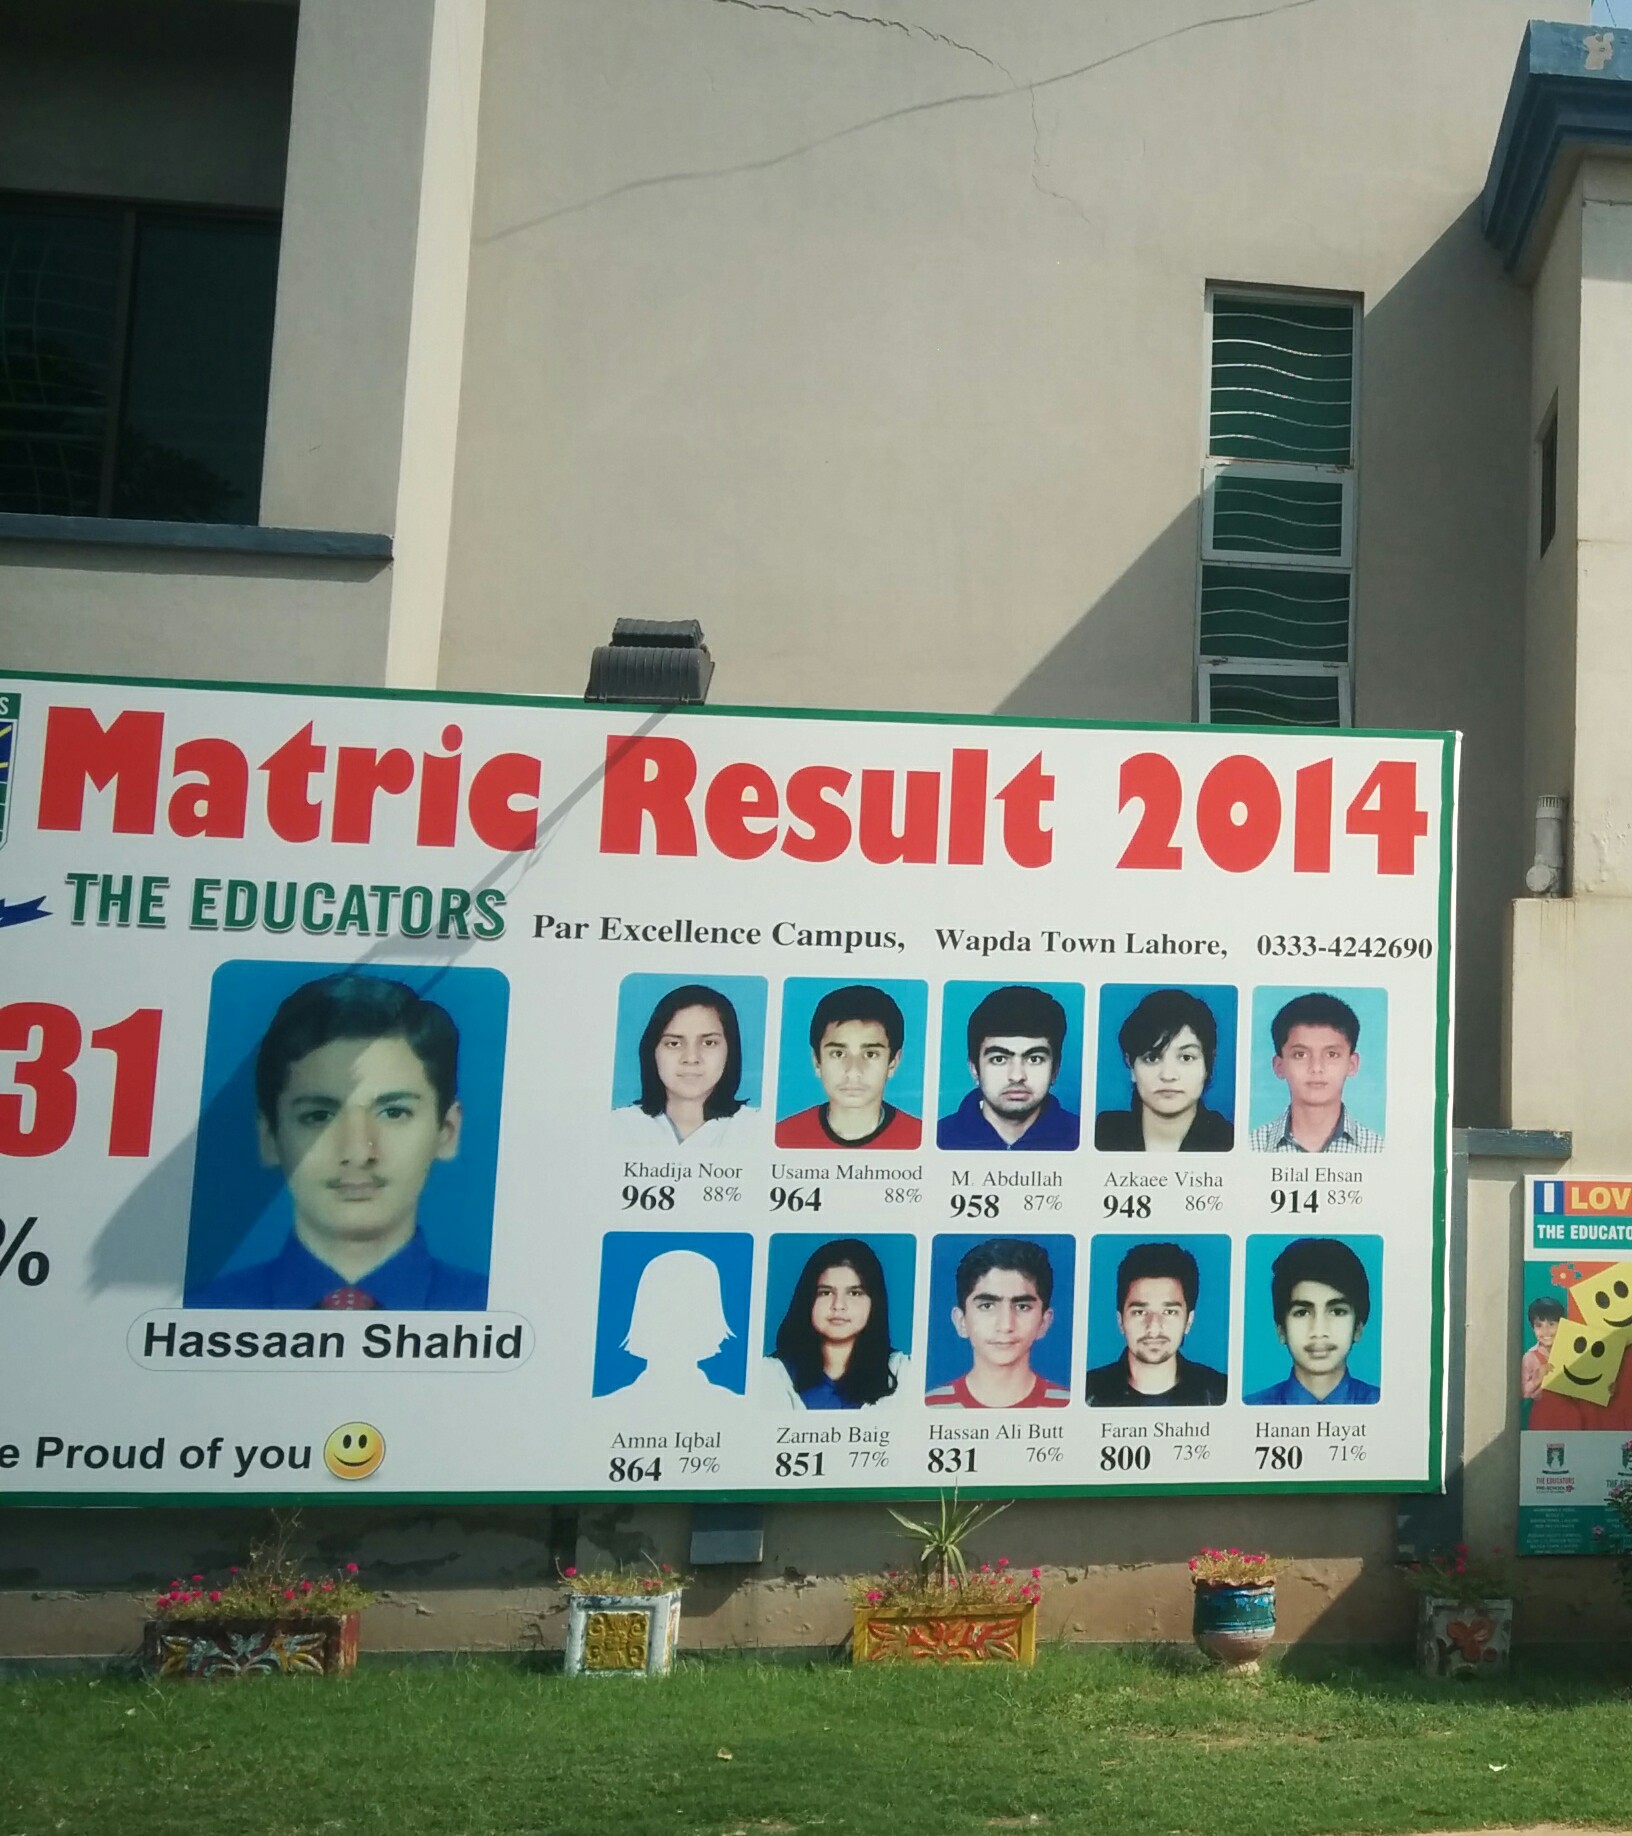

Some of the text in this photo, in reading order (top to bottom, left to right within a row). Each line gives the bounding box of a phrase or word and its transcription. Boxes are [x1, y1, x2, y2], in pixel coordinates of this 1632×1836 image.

[37, 706, 1428, 875] Matric Result 2014
[65, 872, 507, 940] THE EDUCATORS
[533, 915, 1432, 958] Par Excellence Campus, Wapda Town Lahore, 0333-4242690
[625, 1162, 743, 1180] Khadija Noor
[772, 1164, 922, 1179] Usama Mahmood
[985, 1171, 1061, 1186] Abdullah
[1105, 1172, 1222, 1187] Azkaee Visha
[1272, 1168, 1362, 1182] Bilal Ehsan
[623, 1186, 741, 1210] 968 88%
[770, 1187, 922, 1211] 964 88%
[951, 1195, 1060, 1218] 958 87%
[1104, 1195, 1220, 1218] 948 86%
[1271, 1190, 1359, 1213] 914 83%
[1544, 1183, 1554, 1212] I
[1537, 1225, 1564, 1239] THE
[144, 1322, 522, 1358] Hassaan Shahid
[777, 1427, 889, 1446] Zarnab Baig
[930, 1424, 1062, 1439] Hassan Ali Butt
[1102, 1422, 1209, 1438] Faran Shahid
[1257, 1422, 1365, 1441] Hanan Hayat
[613, 1432, 720, 1452] Amna Iqbal
[36, 1437, 164, 1469] Proud
[180, 1438, 224, 1469] of
[234, 1446, 311, 1478] you
[776, 1451, 888, 1476] 851 77%
[928, 1447, 1062, 1472] 831 76%
[1101, 1445, 1209, 1470] 800 73%
[1256, 1446, 1366, 1469] 780 71%
[609, 1457, 719, 1482] 864 79%
